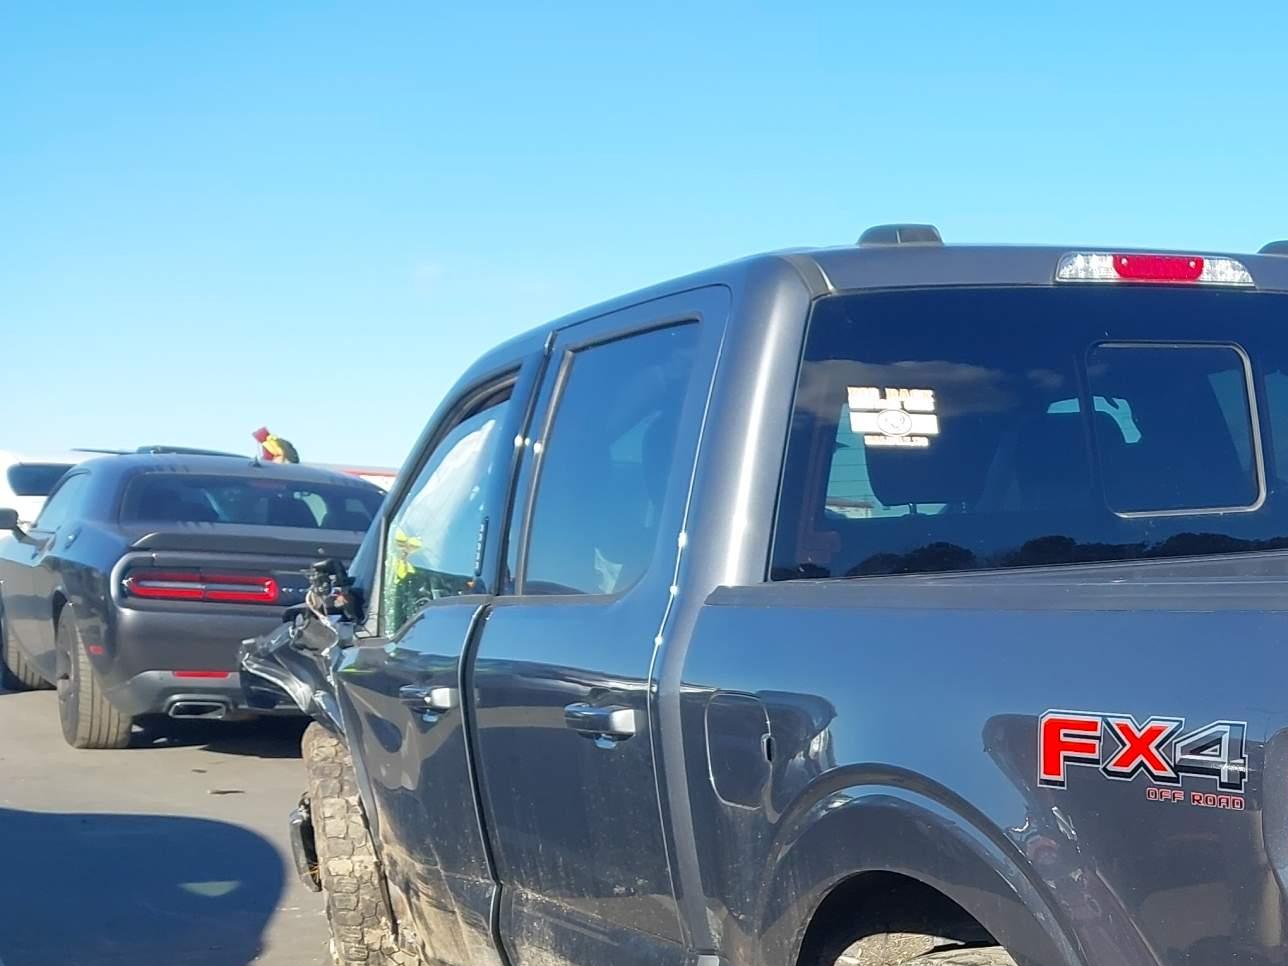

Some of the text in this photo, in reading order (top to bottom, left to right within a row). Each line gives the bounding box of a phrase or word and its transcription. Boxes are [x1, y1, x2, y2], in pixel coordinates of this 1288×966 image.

[1037, 708, 1248, 791] FX4
[1146, 787, 1245, 811] OFF ROAD
